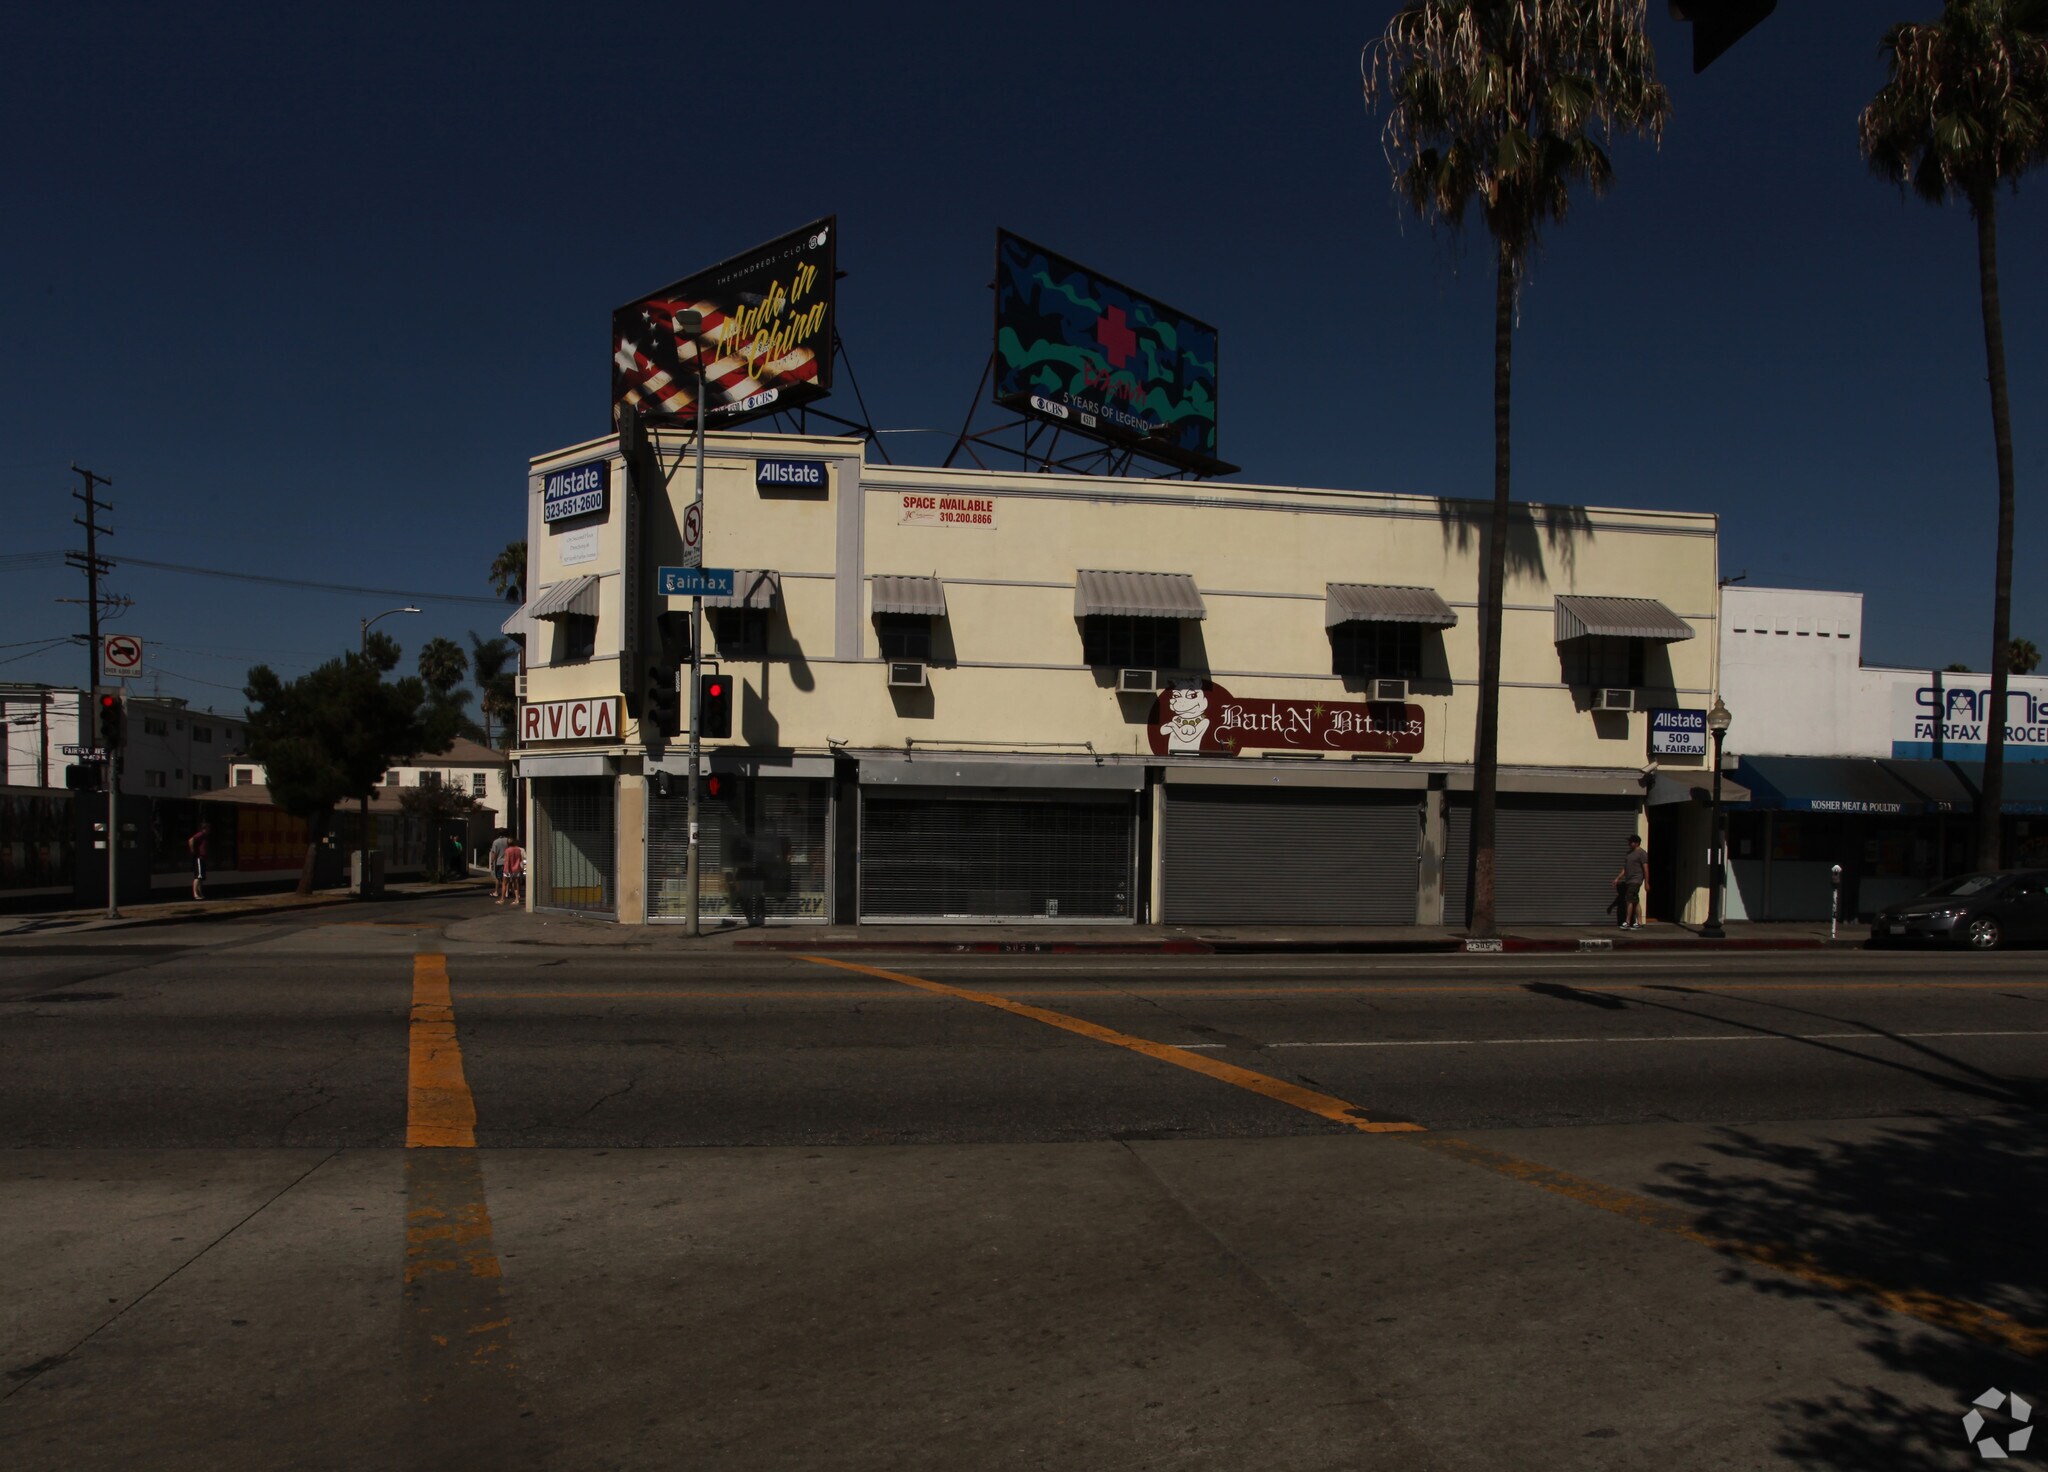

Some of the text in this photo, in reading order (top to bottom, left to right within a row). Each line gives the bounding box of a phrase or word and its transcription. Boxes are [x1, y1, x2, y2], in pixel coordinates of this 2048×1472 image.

[717, 275, 731, 286] THE
[733, 256, 776, 278] HUNDREDS
[715, 261, 818, 365] Made in
[748, 302, 829, 380] China
[756, 391, 773, 404] CBS
[1063, 392, 1069, 403] 5
[1071, 395, 1099, 414] YEARS
[1101, 405, 1113, 419] OF
[1045, 400, 1063, 417] CBS
[758, 463, 819, 483] Allstate
[545, 468, 599, 500] Allstate
[545, 493, 602, 520] 323-651-2600
[903, 496, 993, 512] SPACE AVAILABLE
[666, 573, 727, 592] Fairfax
[526, 702, 612, 738] RVCA
[1324, 710, 1423, 748] Bitches
[1653, 713, 1702, 728] Allstate
[1668, 733, 1690, 743] 509
[1914, 723, 1981, 741] FAIRFAX
[64, 746, 90, 755] FAIRFAX
[1665, 745, 1704, 753] FAIRFAX
[1811, 800, 1901, 813] KOSHER MEAT & POULTRY
